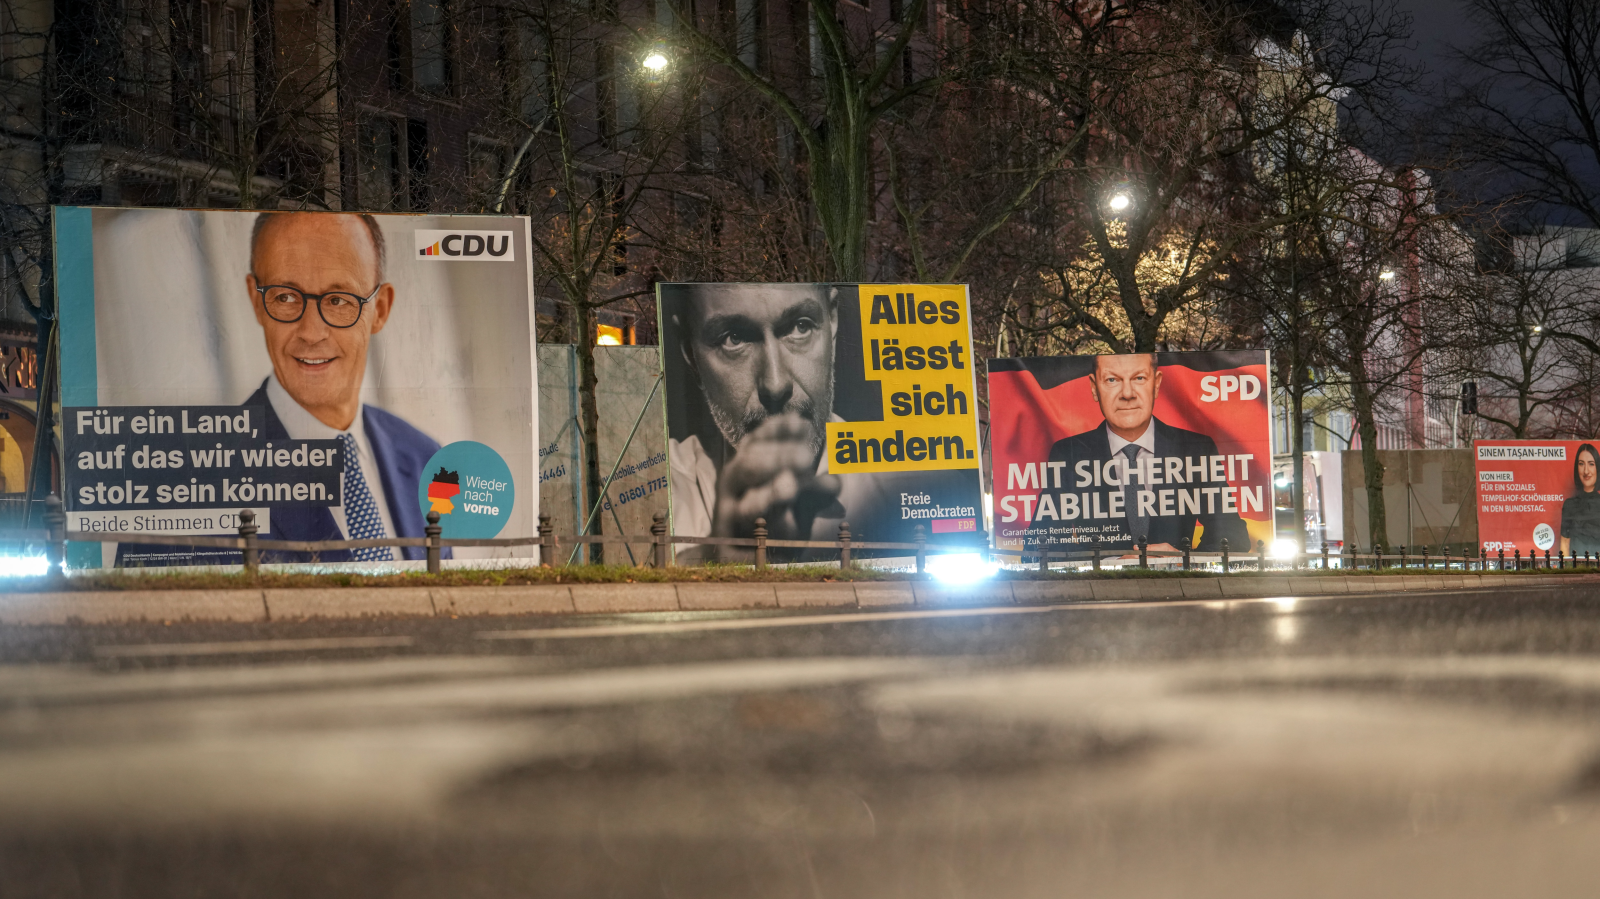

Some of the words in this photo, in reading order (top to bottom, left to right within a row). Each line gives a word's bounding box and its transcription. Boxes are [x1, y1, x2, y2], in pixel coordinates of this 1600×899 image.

[441, 234, 509, 257] CDU
[869, 292, 961, 325] Alles
[870, 338, 965, 371] lässt
[1200, 374, 1262, 403] SPD
[890, 383, 968, 417] sich
[76, 409, 124, 435] Für
[130, 409, 175, 435] ein
[181, 409, 259, 439] Land,
[835, 429, 975, 465] ändern.
[1479, 448, 1506, 457] SINEM
[1507, 448, 1564, 460] TAŞAN-FUNKE
[77, 444, 126, 470] auf
[131, 444, 184, 470] das
[190, 442, 236, 468] wir
[241, 442, 337, 468] wieder
[1007, 461, 1067, 490] MIT
[1075, 453, 1254, 489] SICHERHEIT
[1480, 473, 1495, 481] VON
[1496, 473, 1513, 481] HIER.
[78, 480, 150, 505] stolz
[156, 477, 216, 504] sein
[222, 477, 335, 502] können.
[466, 475, 508, 492] Wieder
[1481, 482, 1494, 491] FÜR
[1495, 483, 1506, 491] EIN
[1506, 483, 1536, 491] SOZIALES
[464, 490, 493, 503] nach
[900, 491, 931, 506] Freie
[1000, 490, 1126, 523] STABILE
[1137, 485, 1264, 518] RENTEN
[1481, 493, 1564, 502] TEMPELHOF-SCHÖNEBERG
[463, 502, 500, 516] vorne
[901, 504, 976, 520] Demokraten
[1505, 504, 1546, 512] BUNDESTAG.
[79, 515, 129, 533] Beide
[133, 513, 214, 531] Stimmen
[958, 520, 975, 530] FDP
[1002, 526, 1048, 537] Garantiertes
[1049, 526, 1100, 535] Rentenniveau.
[1102, 524, 1120, 533] Jetzt
[1003, 537, 1017, 546] und
[1018, 537, 1026, 546] in
[1027, 536, 1059, 546] Zuknft:
[1483, 541, 1503, 552] SPD
